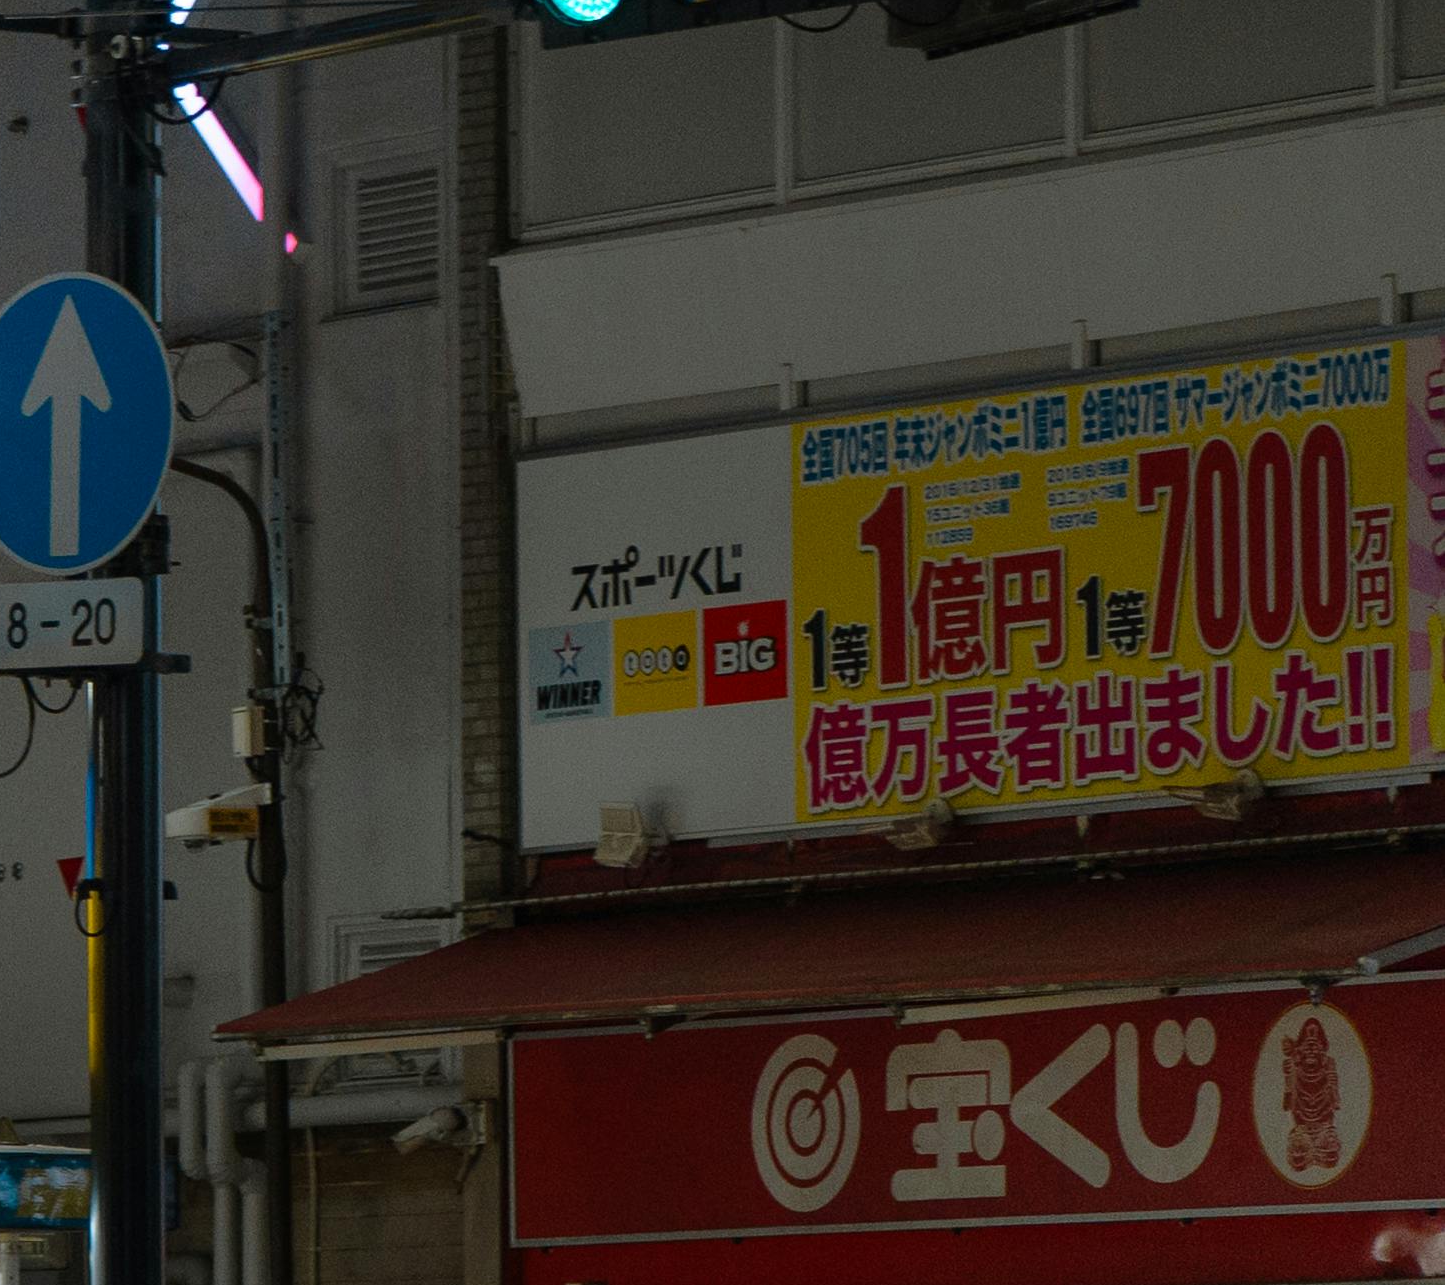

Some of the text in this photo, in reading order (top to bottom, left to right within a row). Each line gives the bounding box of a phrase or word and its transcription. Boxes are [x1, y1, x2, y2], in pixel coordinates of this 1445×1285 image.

[1080, 389, 1170, 446] 全国697回
[801, 424, 890, 483] 全国705回
[571, 546, 742, 610] スポーツくじ
[860, 485, 1064, 688] 1億円
[1077, 575, 1147, 659] 1等
[623, 645, 691, 677] toto
[714, 637, 777, 676] BIG
[805, 608, 869, 691] 1等
[537, 680, 601, 711] WINNER
[803, 647, 1394, 812] 億万長者出ました!!
[886, 1015, 1222, 1203] 宝くじ
